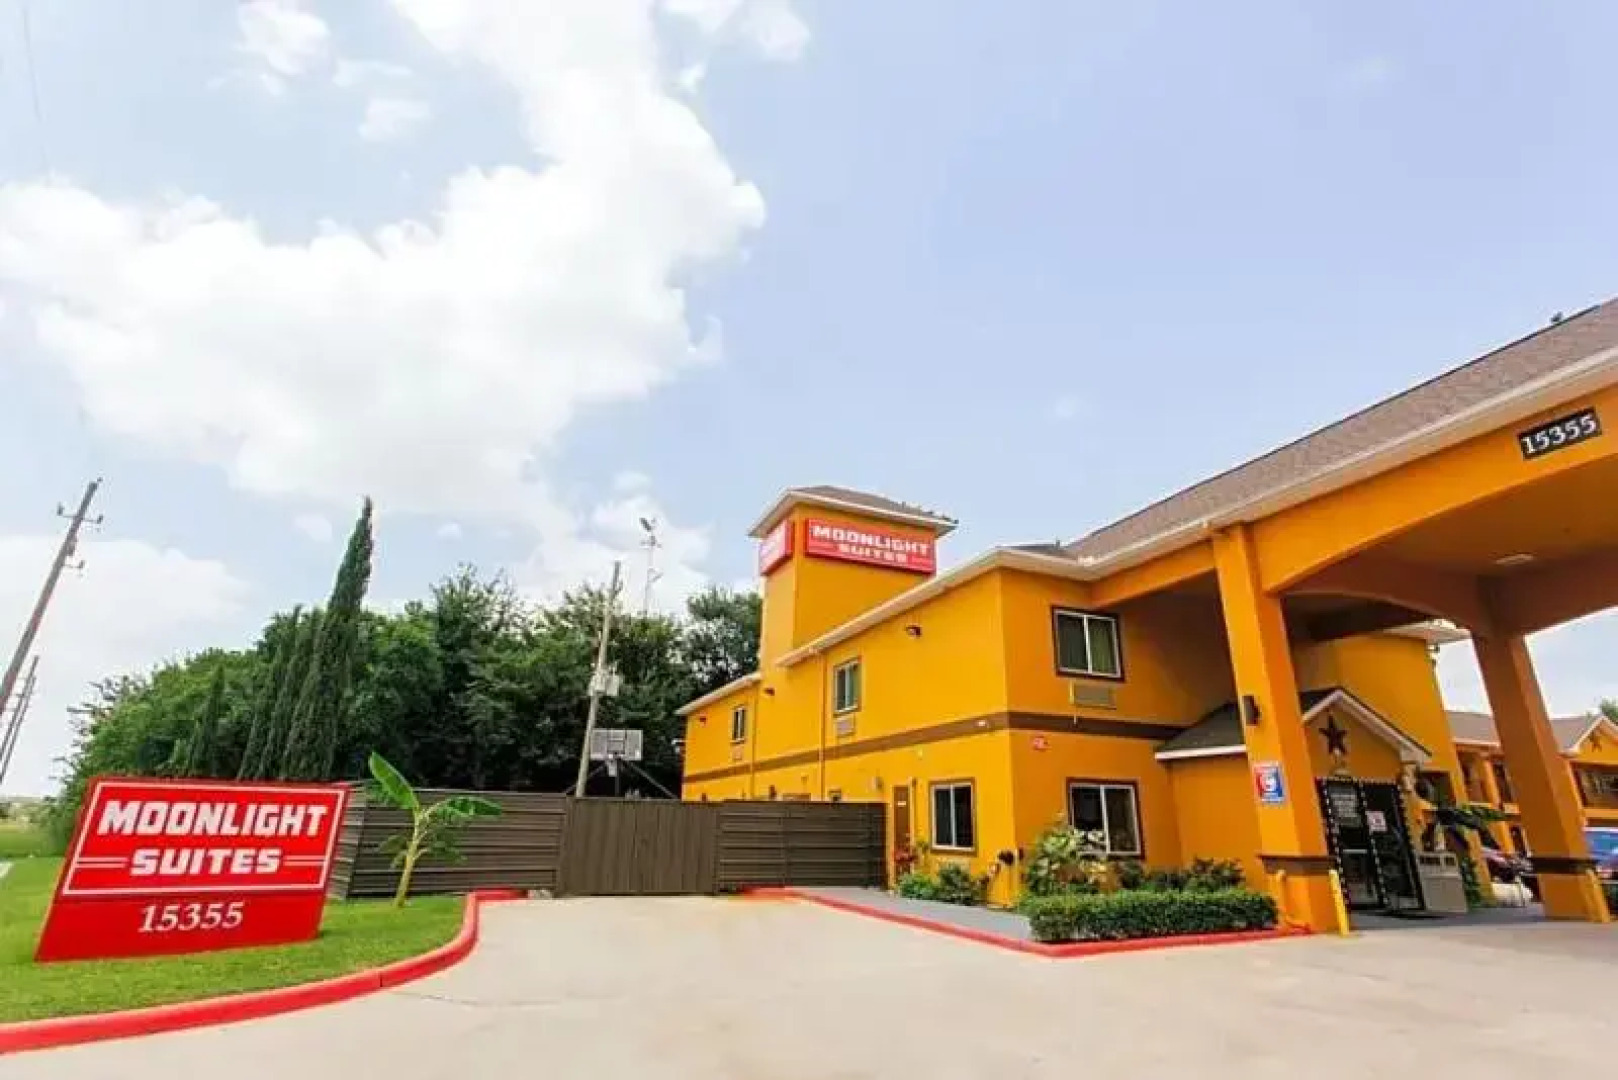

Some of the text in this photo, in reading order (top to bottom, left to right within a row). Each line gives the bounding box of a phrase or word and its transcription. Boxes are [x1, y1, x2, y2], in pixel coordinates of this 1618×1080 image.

[1521, 414, 1597, 453] 15355
[812, 524, 931, 555] MOONLIGHT
[837, 543, 908, 563] SUITES
[97, 800, 327, 837] MOONLIGHT
[130, 848, 282, 876] SUITES
[138, 901, 244, 932] 15355
